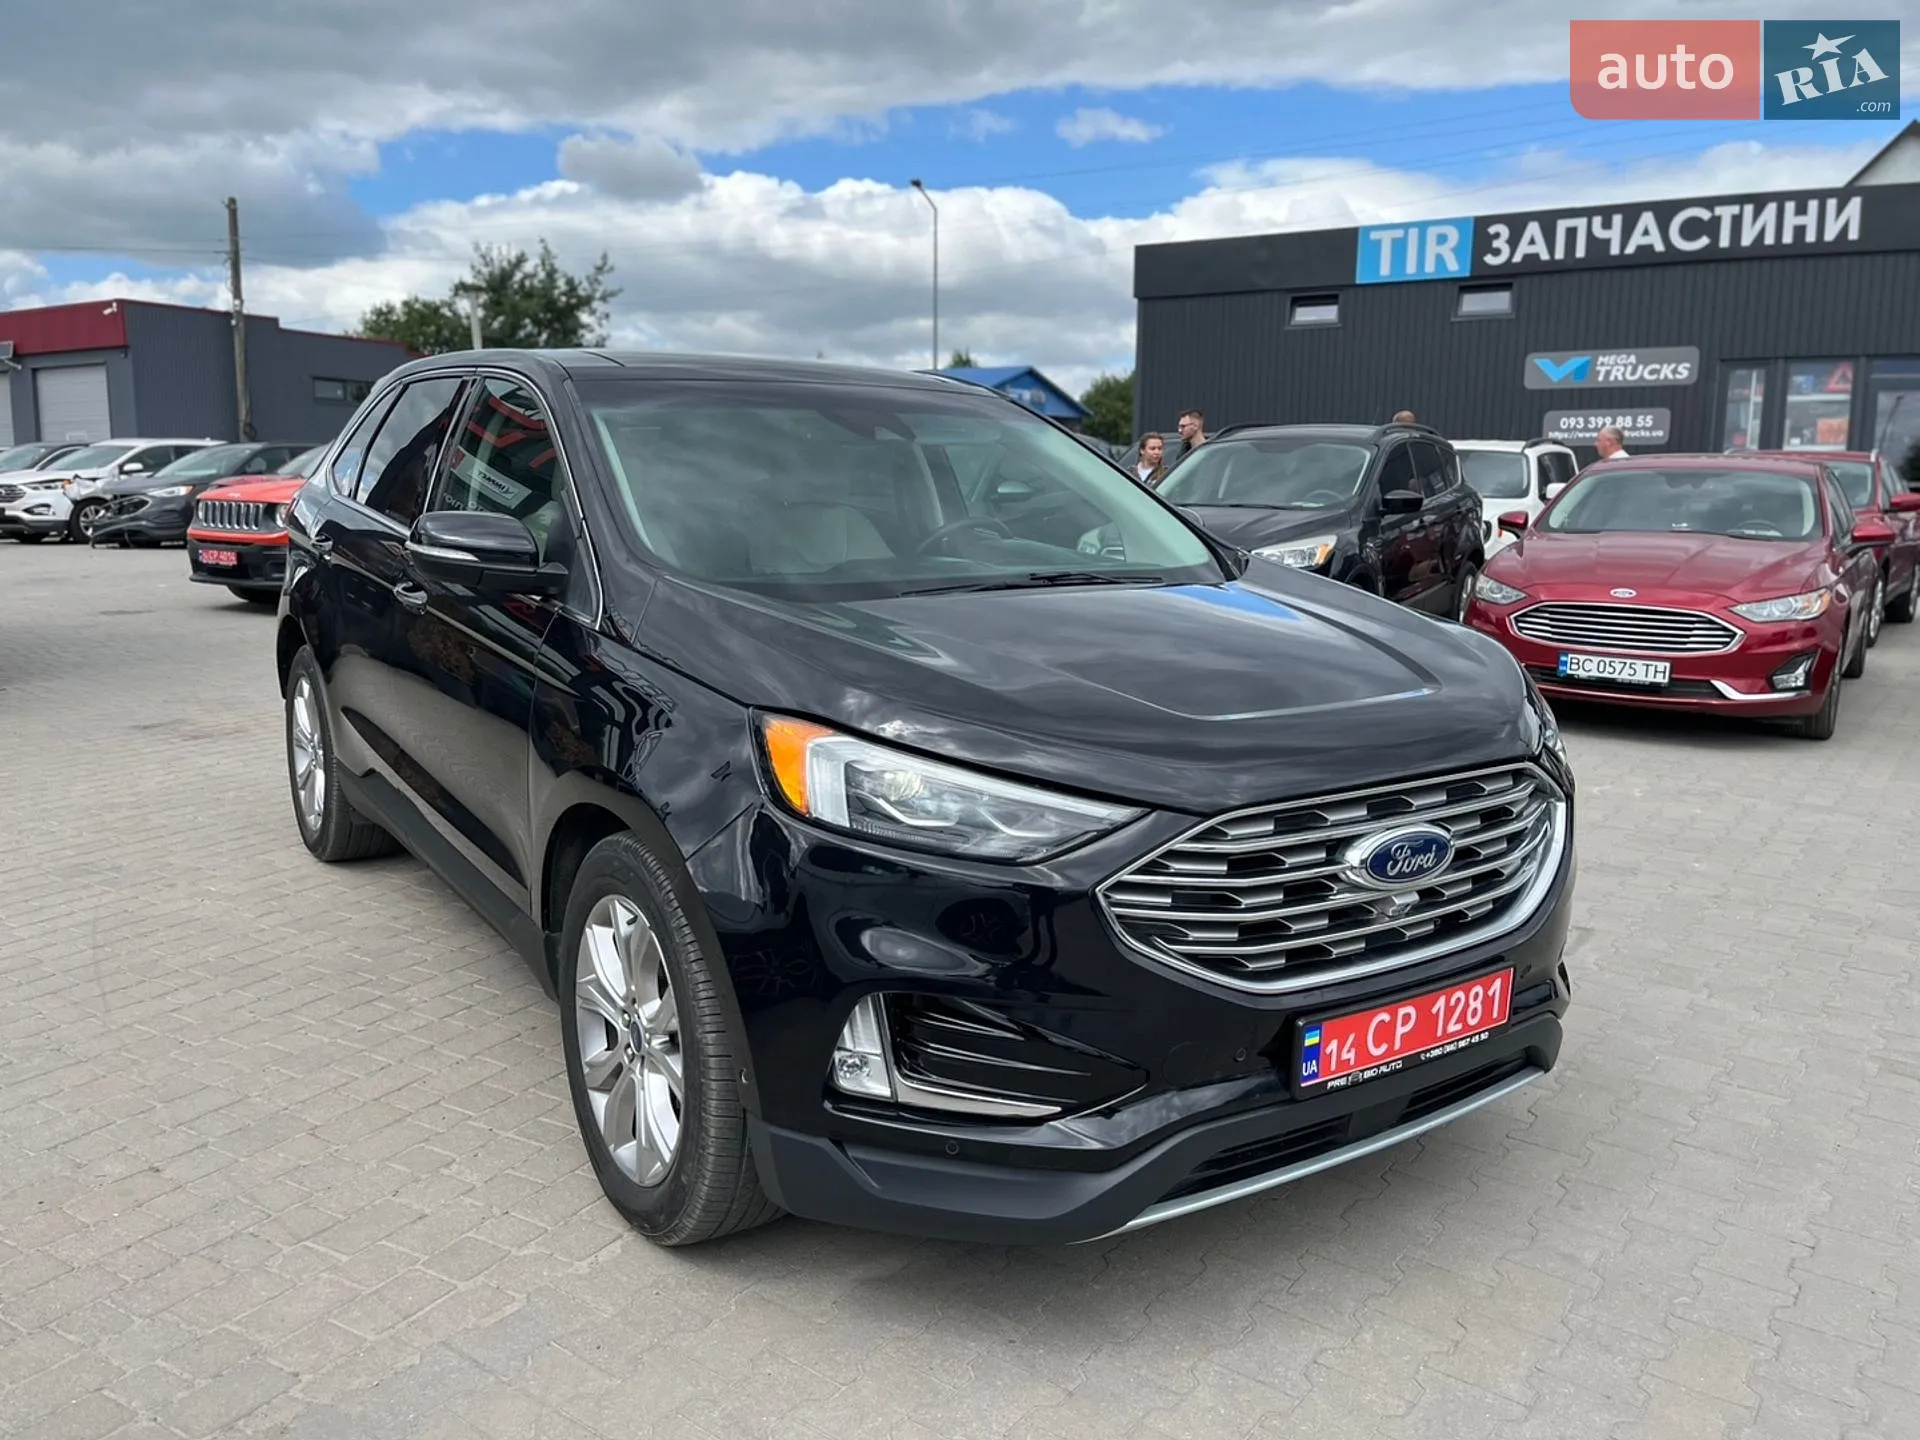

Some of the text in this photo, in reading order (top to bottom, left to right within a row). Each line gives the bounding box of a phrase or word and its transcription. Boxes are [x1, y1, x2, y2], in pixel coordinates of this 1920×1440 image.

[1483, 196, 1862, 267] ЗАПЧАСТИНИ
[1370, 225, 1460, 277] TIR
[1596, 354, 1636, 365] MEGA
[1596, 363, 1691, 382] TRUCKS
[1560, 414, 1653, 429] 093 399 88 55
[1569, 657, 1594, 673] BC
[1597, 659, 1637, 677] 0575
[1642, 663, 1668, 680] TH
[1386, 840, 1437, 876] Ford
[1324, 977, 1502, 1072] 14 CP 1281
[1302, 1060, 1318, 1076] UA
